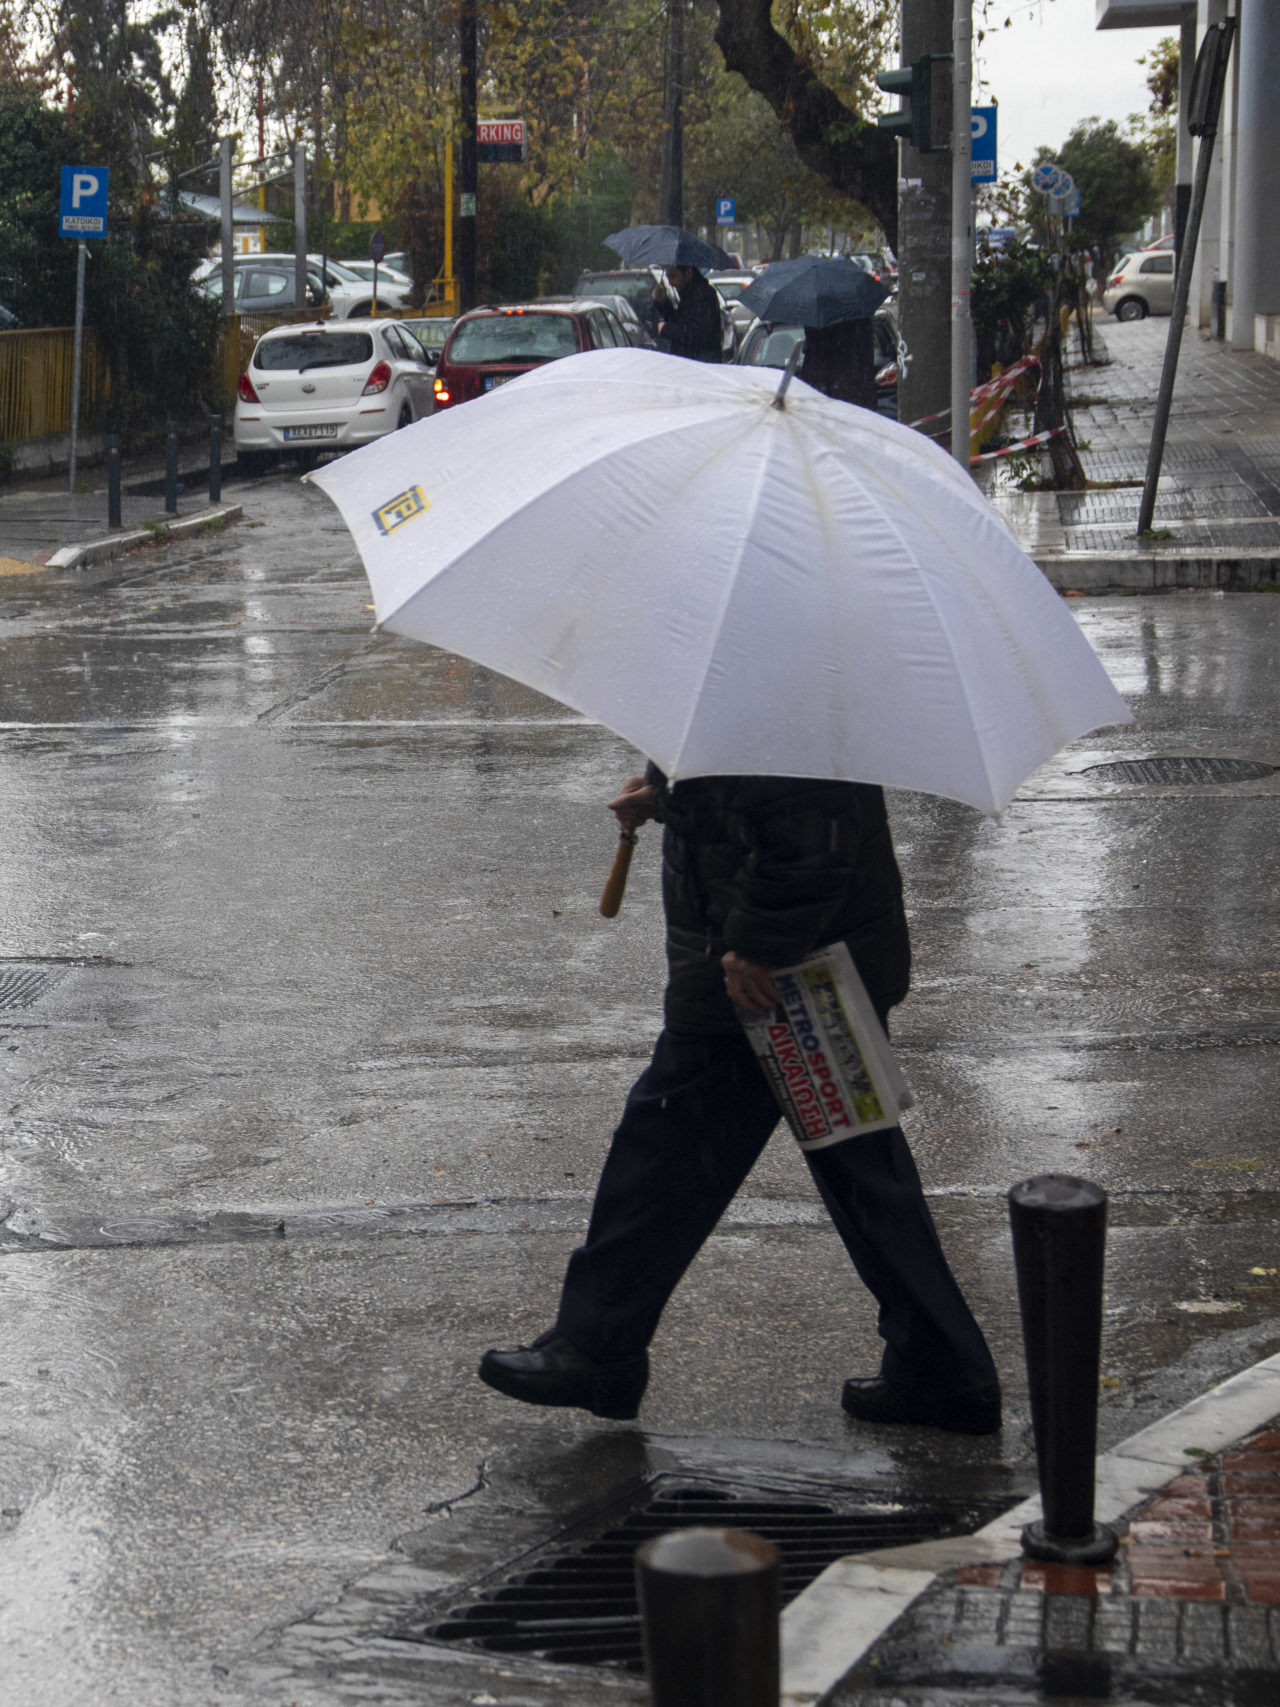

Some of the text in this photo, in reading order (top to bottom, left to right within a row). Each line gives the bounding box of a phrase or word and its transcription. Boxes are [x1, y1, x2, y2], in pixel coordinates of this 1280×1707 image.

[478, 125, 521, 140] RKING
[72, 173, 99, 208] P
[720, 201, 732, 215] P
[775, 973, 852, 1128] METROSPORT
[767, 1022, 830, 1139] ΔΙΚΑΙΩΣΗ
